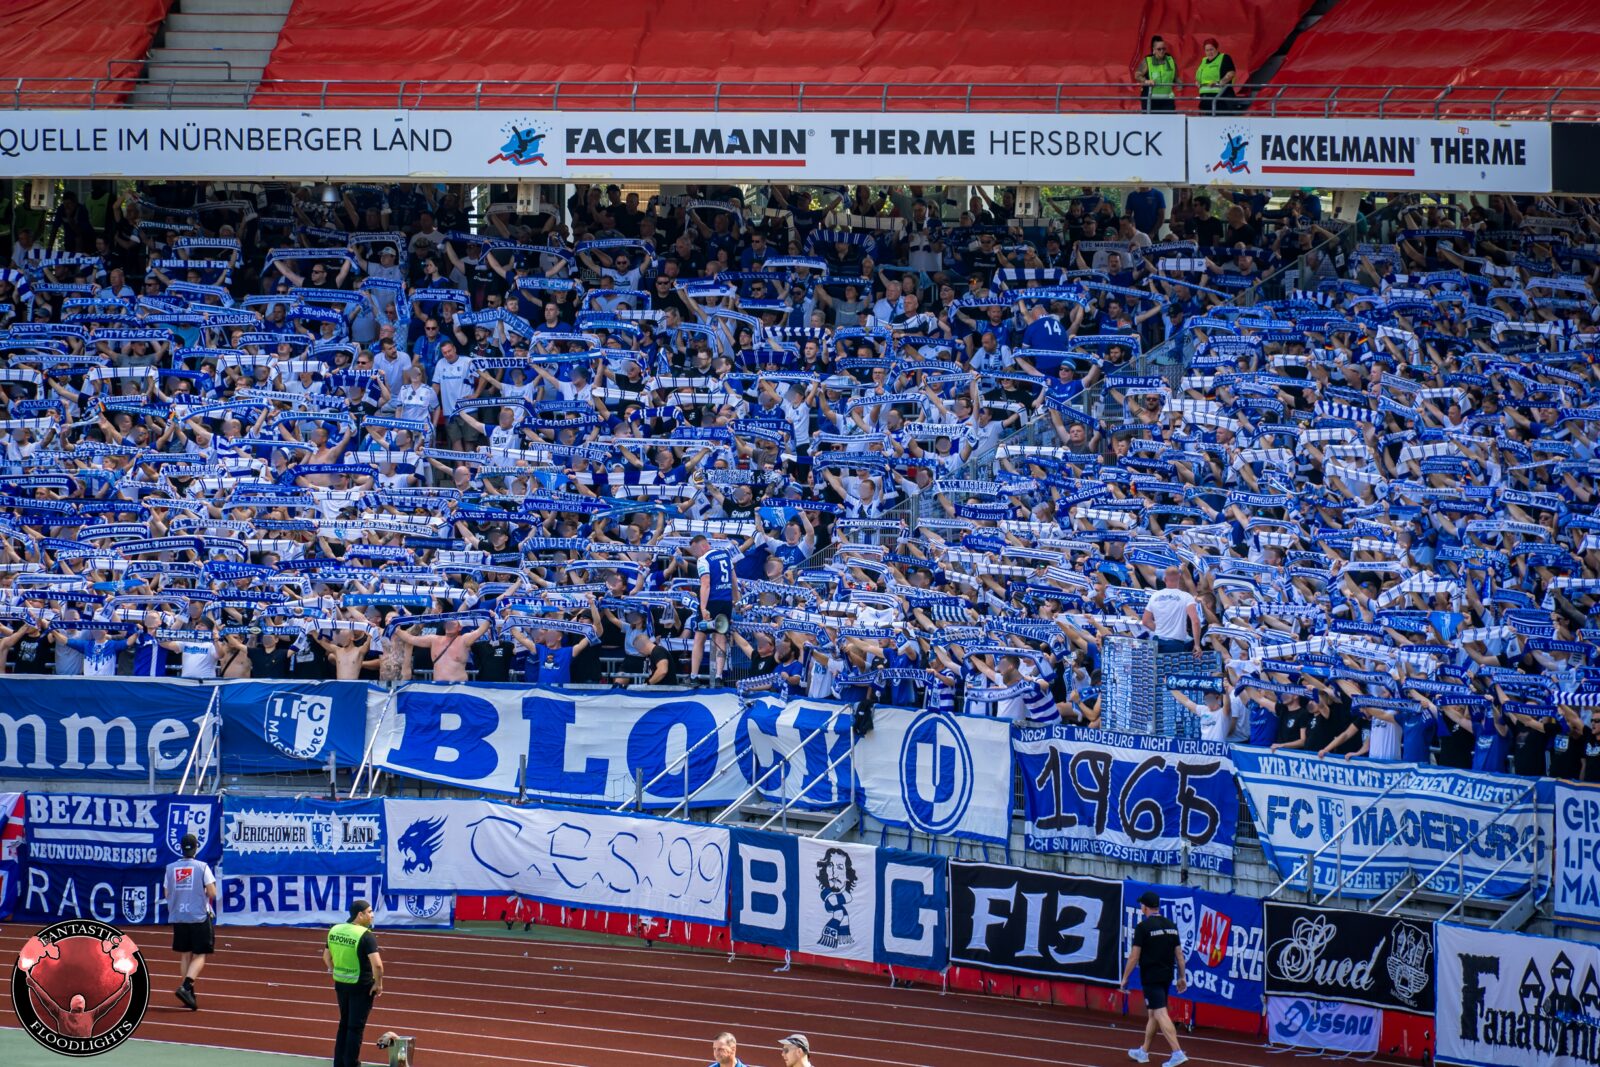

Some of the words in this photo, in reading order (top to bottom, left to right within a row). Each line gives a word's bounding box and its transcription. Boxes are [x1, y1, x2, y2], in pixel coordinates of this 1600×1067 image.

[0, 129, 107, 157] QUELLE
[118, 129, 149, 152] IM
[161, 122, 362, 152] NÜRNBERGER
[373, 127, 453, 152] LAND
[832, 129, 975, 155] THERME
[990, 131, 1163, 156] HERSBRUCK
[1261, 134, 1415, 163] FACKELMANN
[1431, 137, 1526, 166] THERME
[187, 260, 207, 268] DER
[93, 329, 170, 338] WITTENBERG
[1044, 319, 1063, 336] 14
[1106, 377, 1125, 388] NUR
[1126, 377, 1144, 387] DER
[14, 498, 76, 516] MAGDEBURG
[784, 500, 830, 511] immer
[960, 508, 973, 519] für
[491, 512, 508, 520] DER
[158, 540, 195, 549] SEEHAUSEN
[525, 539, 546, 551] NUR
[547, 538, 571, 550] DER
[128, 562, 158, 573] CLUB
[719, 559, 729, 584] 5
[46, 591, 99, 603] immer
[240, 590, 262, 599] DER
[156, 629, 195, 639] BEZIRK
[198, 629, 212, 639] 39
[868, 628, 886, 637] DER
[987, 620, 1005, 632] BLUE
[1005, 624, 1051, 641] GENERATION
[1336, 621, 1385, 633] MAGDEBURG
[1529, 640, 1545, 652] für
[1549, 642, 1588, 653] immer
[883, 669, 899, 679] BLUE
[1444, 667, 1462, 676] DER
[273, 697, 327, 722] 1.FC
[1446, 697, 1486, 706] immer
[1518, 705, 1554, 716] immer
[386, 690, 851, 803] BLOCK
[1021, 729, 1047, 742] NOCH
[1052, 725, 1067, 740] IST
[1074, 728, 1134, 748] MAGDEBURG
[1140, 738, 1173, 751] NICHT
[1177, 739, 1231, 756] VERLOREN
[1258, 756, 1288, 776] WIR
[1289, 758, 1356, 785] KÄMPFEN
[1358, 768, 1382, 788] MIT
[1453, 778, 1528, 805] FÄUSTEN
[1036, 745, 1220, 846] 1965
[28, 795, 160, 829] BEZIRK
[172, 809, 207, 826] 1.FC
[1267, 795, 1315, 840] FC
[313, 823, 332, 833] 1.FC
[342, 821, 375, 844] LAND
[30, 842, 158, 865] NEUNUNDDREISSIG
[1070, 838, 1090, 853] WIR
[1151, 851, 1174, 864] AUF
[1175, 852, 1197, 867] DR
[124, 888, 146, 901] 1.FC
[222, 875, 399, 913] BREMEN
[739, 842, 786, 930] B
[883, 862, 938, 957] G
[824, 925, 838, 937] BG
[1266, 914, 1387, 991] Sued
[1220, 978, 1235, 1000] U
[1275, 1000, 1375, 1038] Dessau
